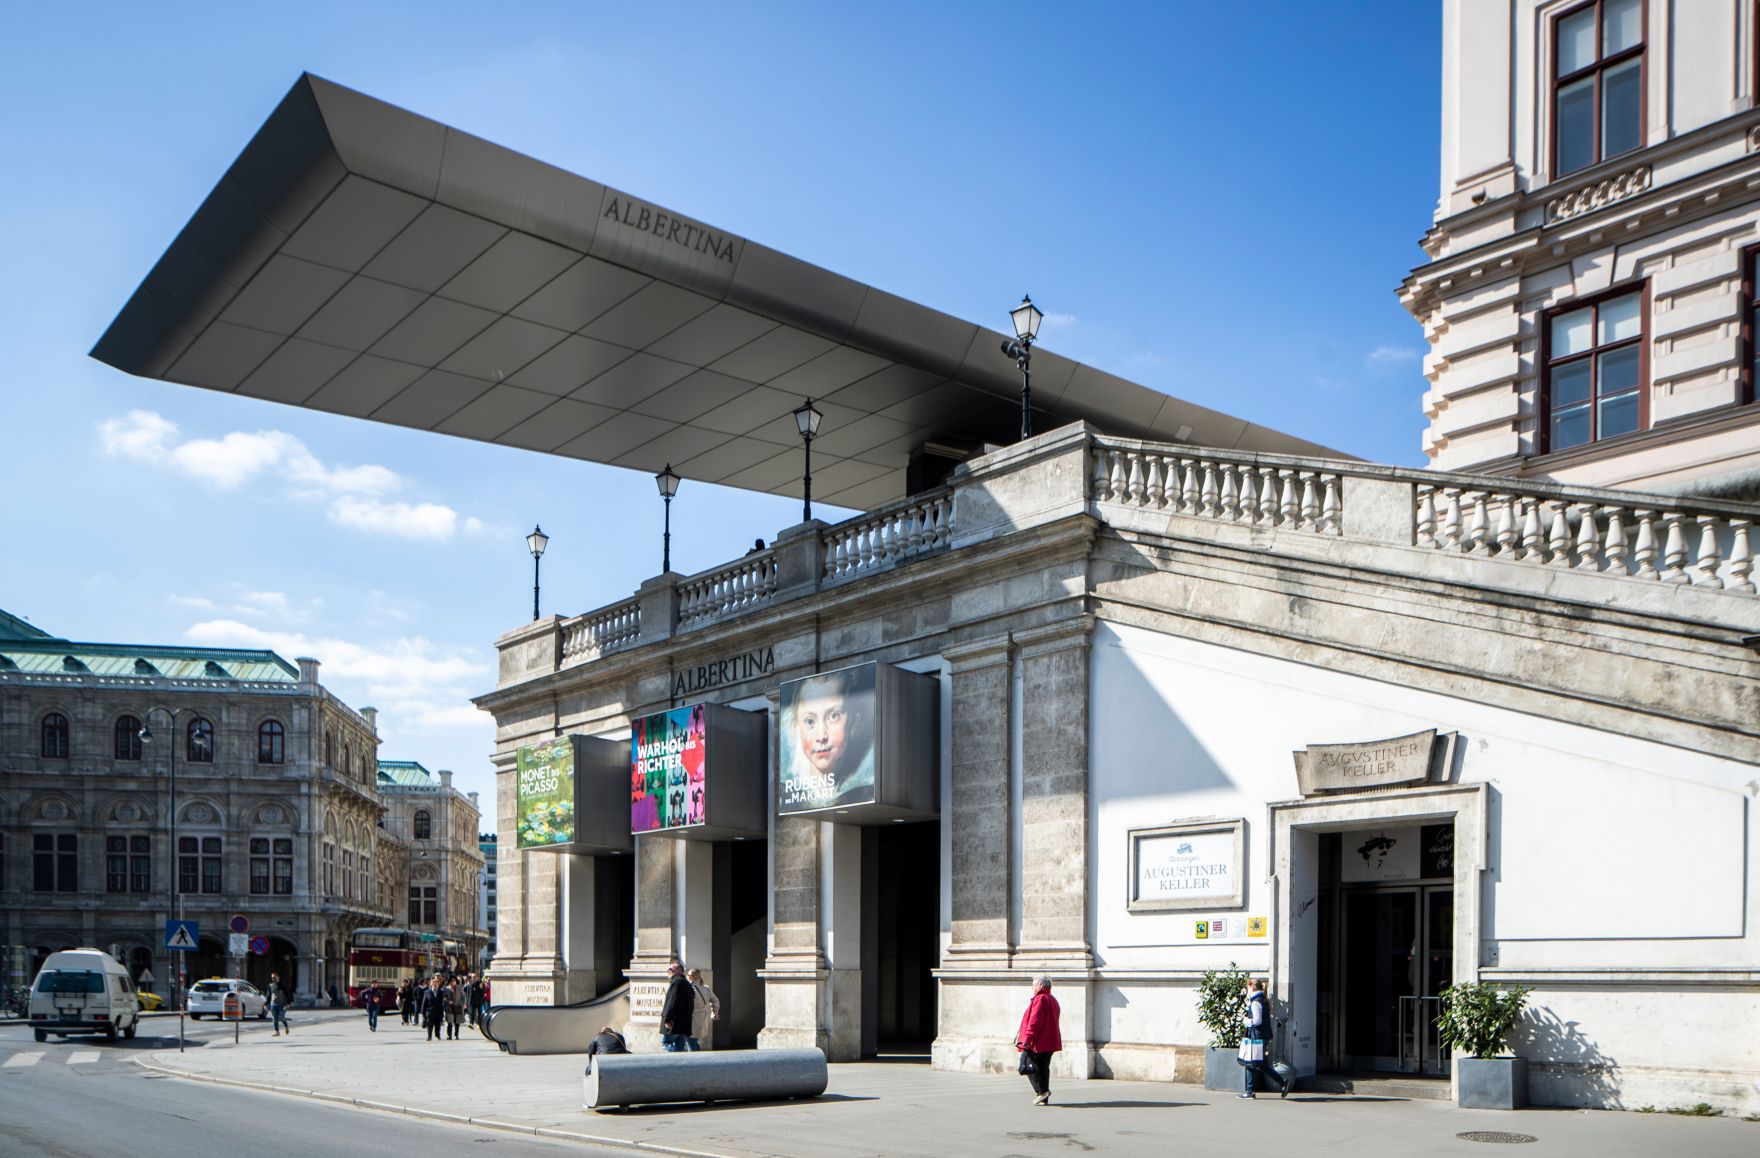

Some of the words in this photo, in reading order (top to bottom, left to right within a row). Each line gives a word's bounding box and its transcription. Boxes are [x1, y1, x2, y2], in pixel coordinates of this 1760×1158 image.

[603, 197, 734, 263] ALBERTINA
[674, 646, 775, 696] ALBERTINA
[637, 738, 684, 758] WARHOL
[685, 740, 696, 751] BIS
[1320, 744, 1418, 767] AUGVSTINER
[637, 754, 682, 774] RICHTER
[1343, 762, 1395, 777] KELLER
[521, 765, 551, 783] MONET
[785, 773, 835, 793] RUBENS
[521, 778, 559, 796] PICASSO
[791, 787, 835, 803] MAKART
[1144, 864, 1228, 879] AUGUSTINER
[1160, 878, 1210, 891] KELLER
[636, 999, 664, 1007] MUSEUM
